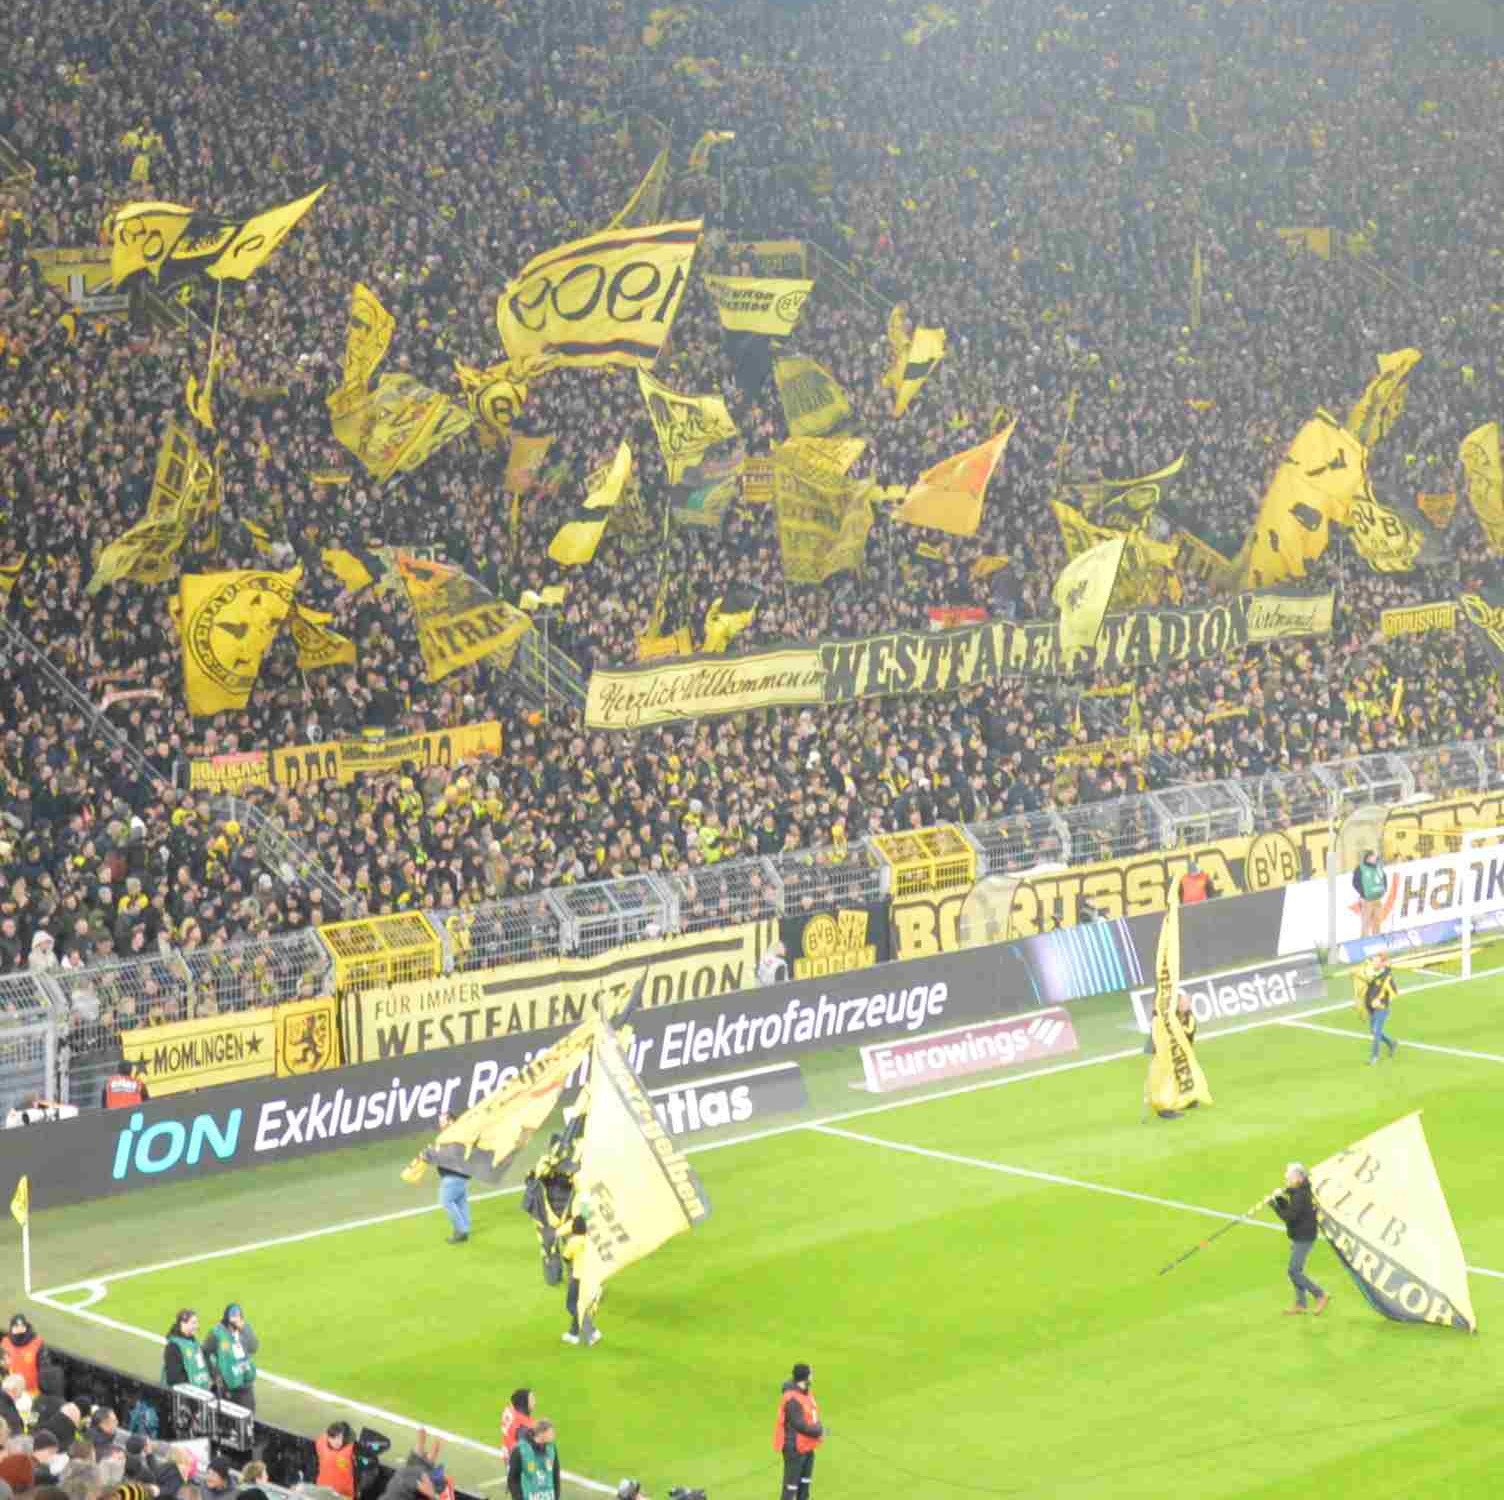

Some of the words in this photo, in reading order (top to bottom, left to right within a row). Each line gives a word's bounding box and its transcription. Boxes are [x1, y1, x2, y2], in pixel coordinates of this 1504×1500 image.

[1255, 843, 1296, 889] BVB
[374, 994, 412, 1021] FÜR
[419, 981, 482, 1015] IMMER
[659, 980, 948, 1069] Elektrofahrzeuge
[876, 1023, 1030, 1082] Eurowings
[253, 1078, 465, 1152] Exklusiver
